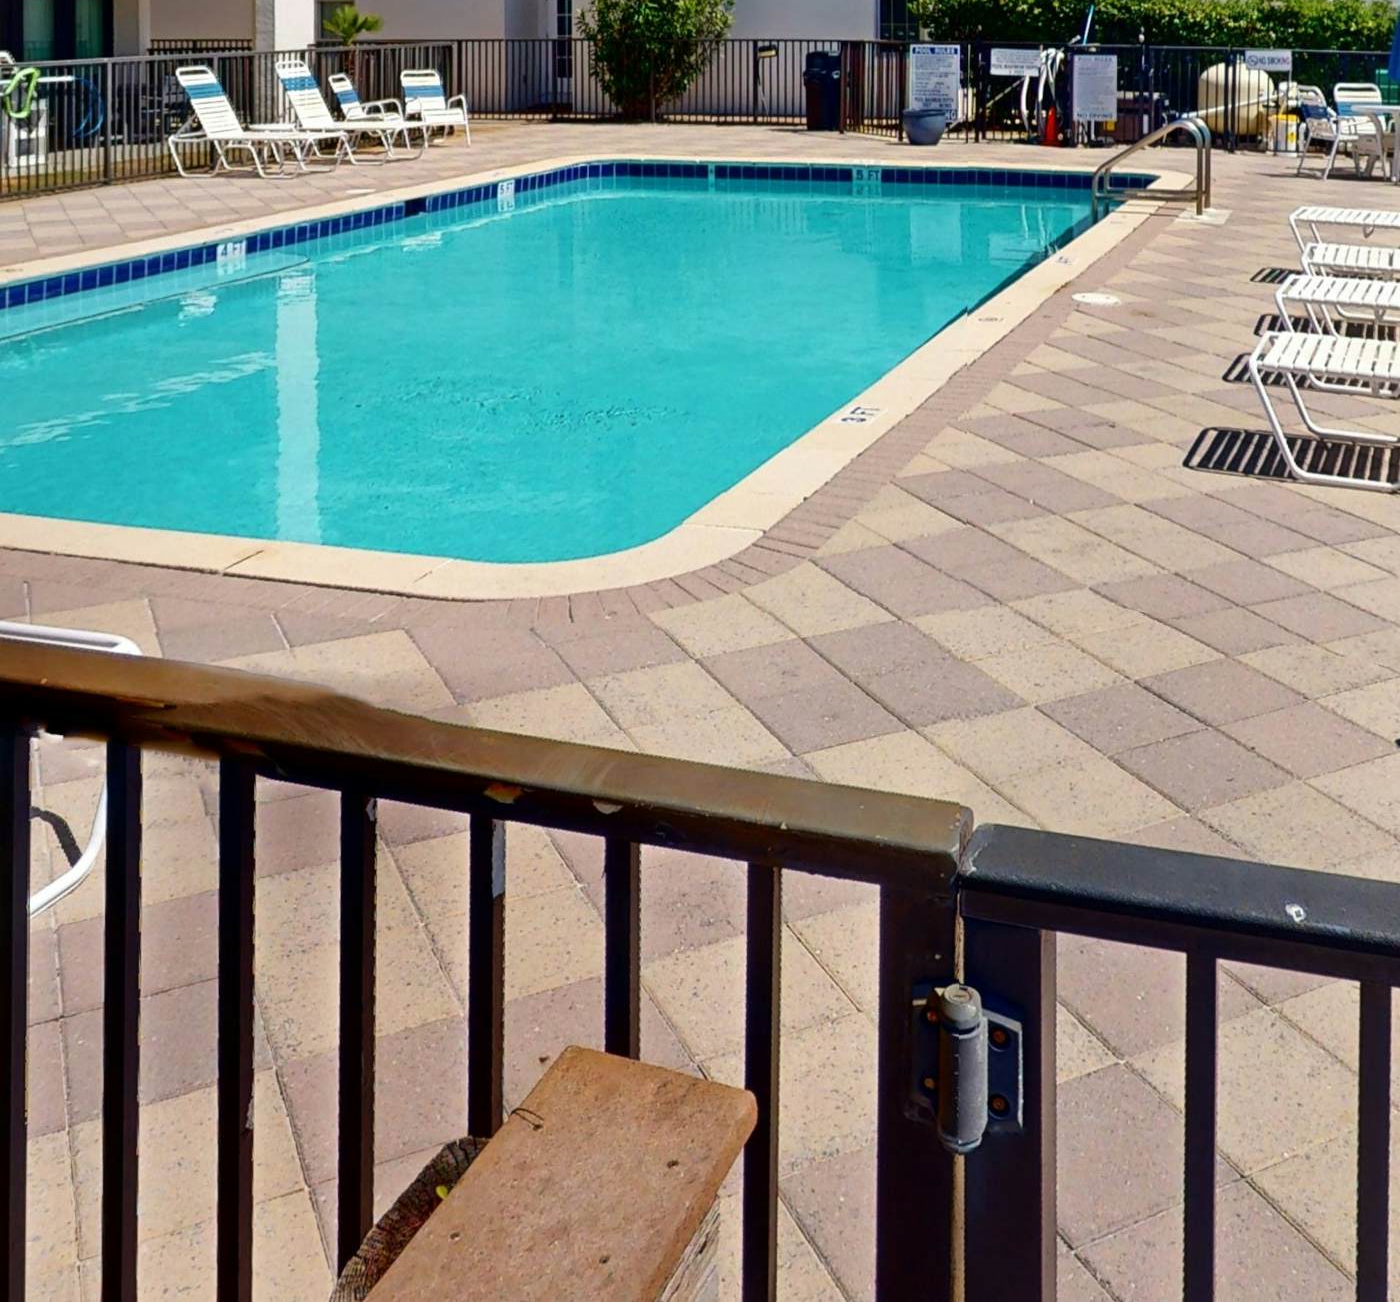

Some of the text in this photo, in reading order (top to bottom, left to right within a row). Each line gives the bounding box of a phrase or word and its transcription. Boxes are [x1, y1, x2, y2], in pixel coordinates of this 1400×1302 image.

[915, 46, 954, 55] POOL RULES
[1259, 56, 1290, 65] NO SMOKING
[868, 169, 880, 181] FT
